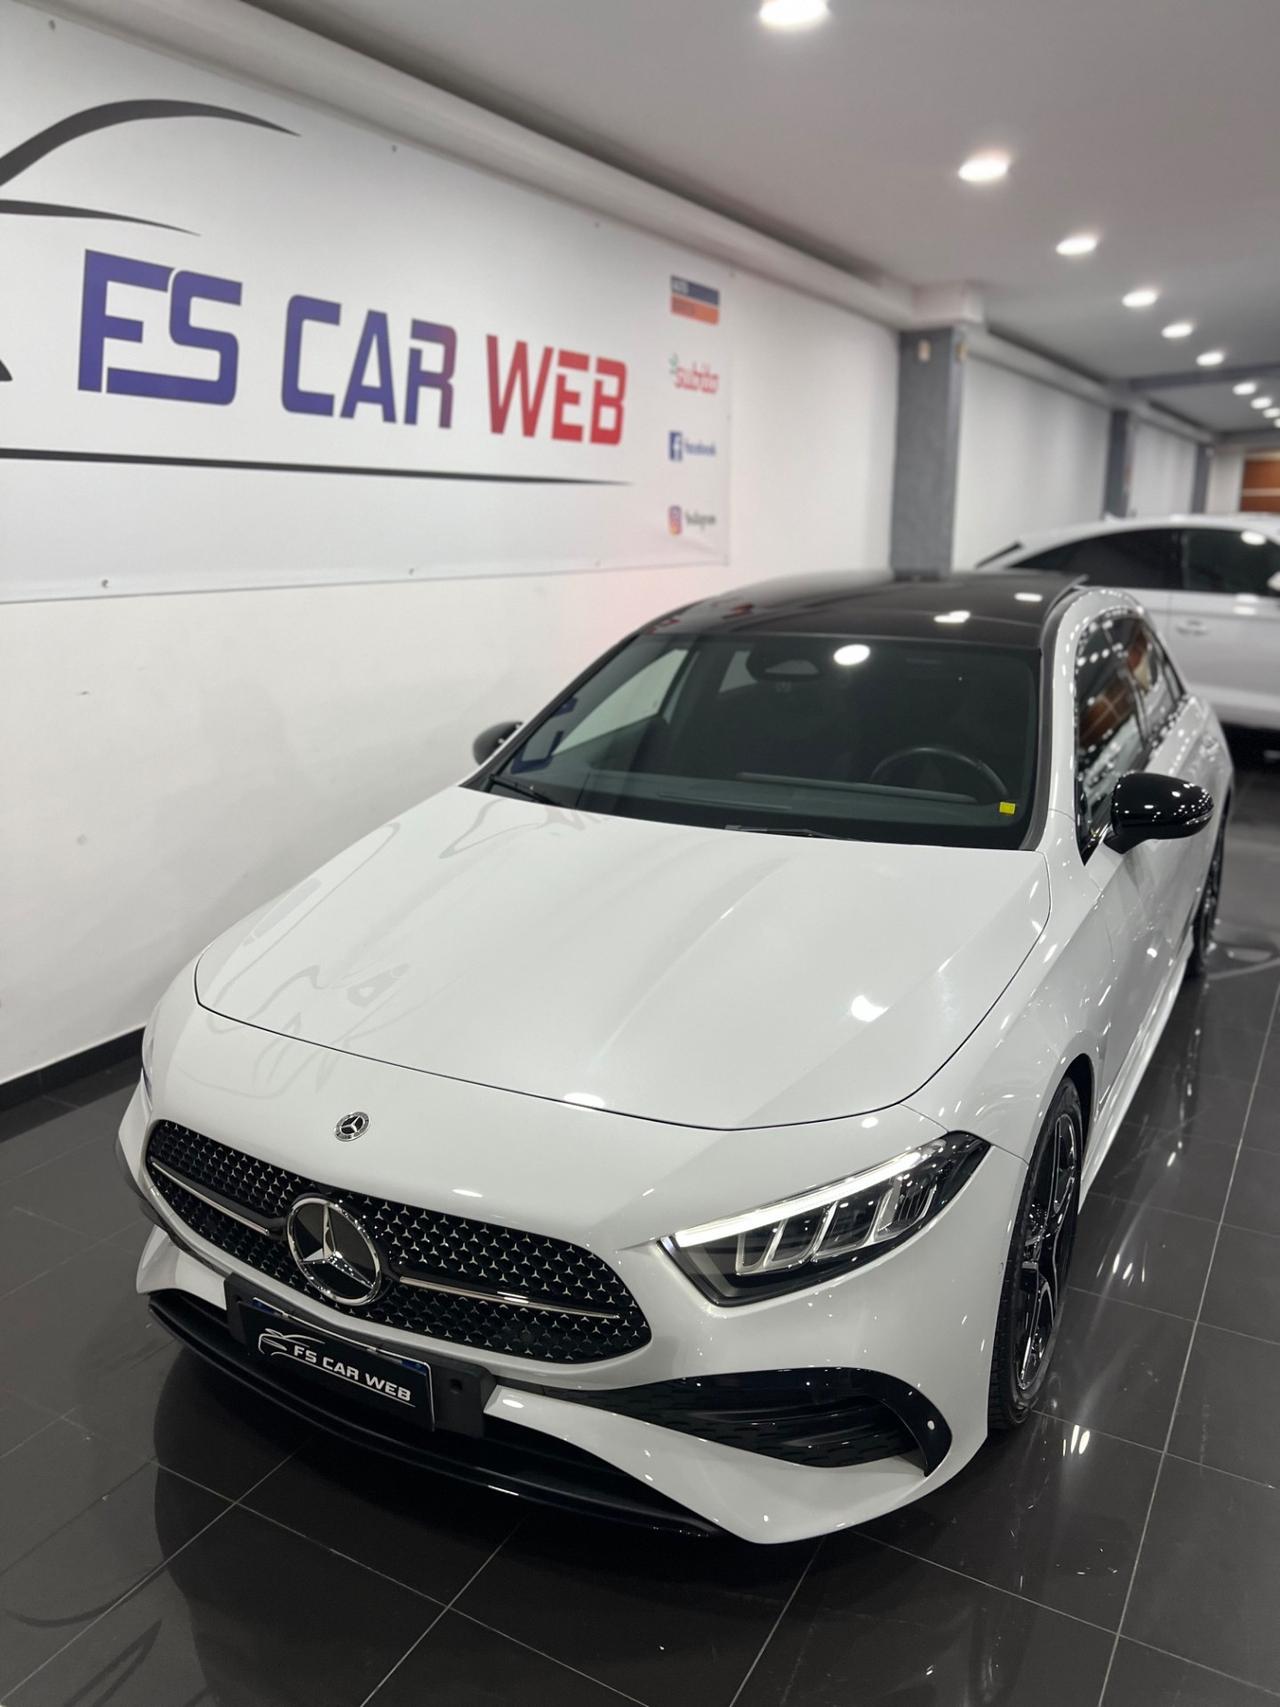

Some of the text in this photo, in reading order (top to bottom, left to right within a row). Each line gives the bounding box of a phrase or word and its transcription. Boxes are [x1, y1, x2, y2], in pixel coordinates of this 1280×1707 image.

[78, 249, 628, 446] FS CAR WEB
[294, 1345, 411, 1401] FS CAR WEB
